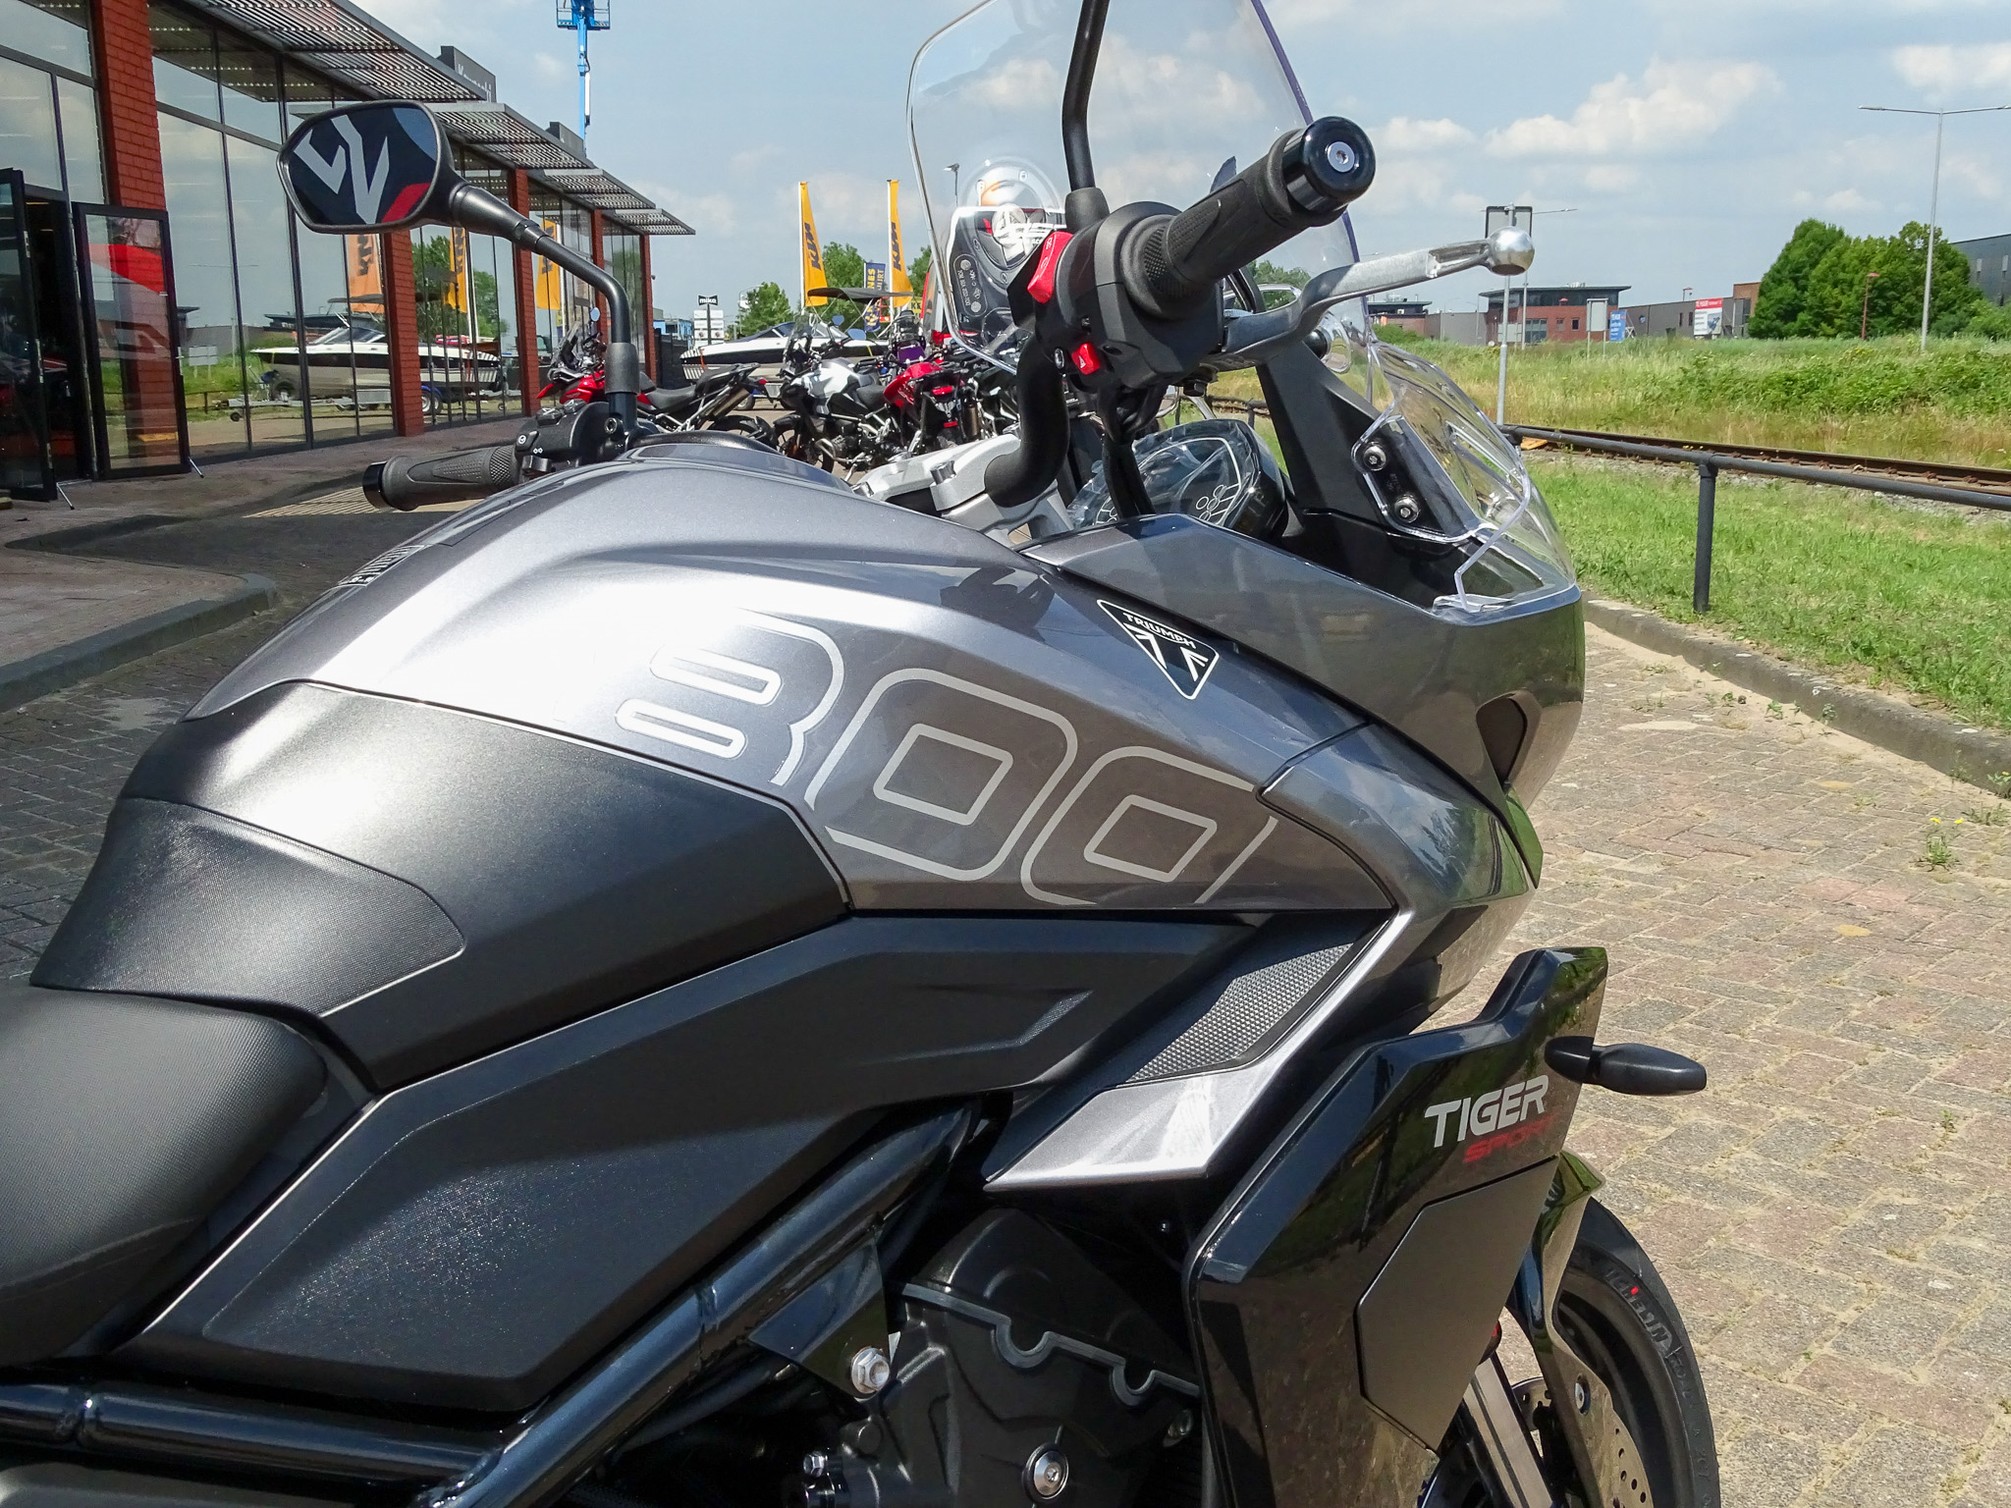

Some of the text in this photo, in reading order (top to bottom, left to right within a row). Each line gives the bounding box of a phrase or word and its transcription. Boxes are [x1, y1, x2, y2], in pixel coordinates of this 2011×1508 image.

[804, 222, 822, 271] KTM
[891, 221, 902, 271] KTM
[1122, 612, 1197, 649] TRIUMPH
[1424, 1074, 1549, 1148] TIGER
[1604, 1268, 1672, 1351] ICHELIN
